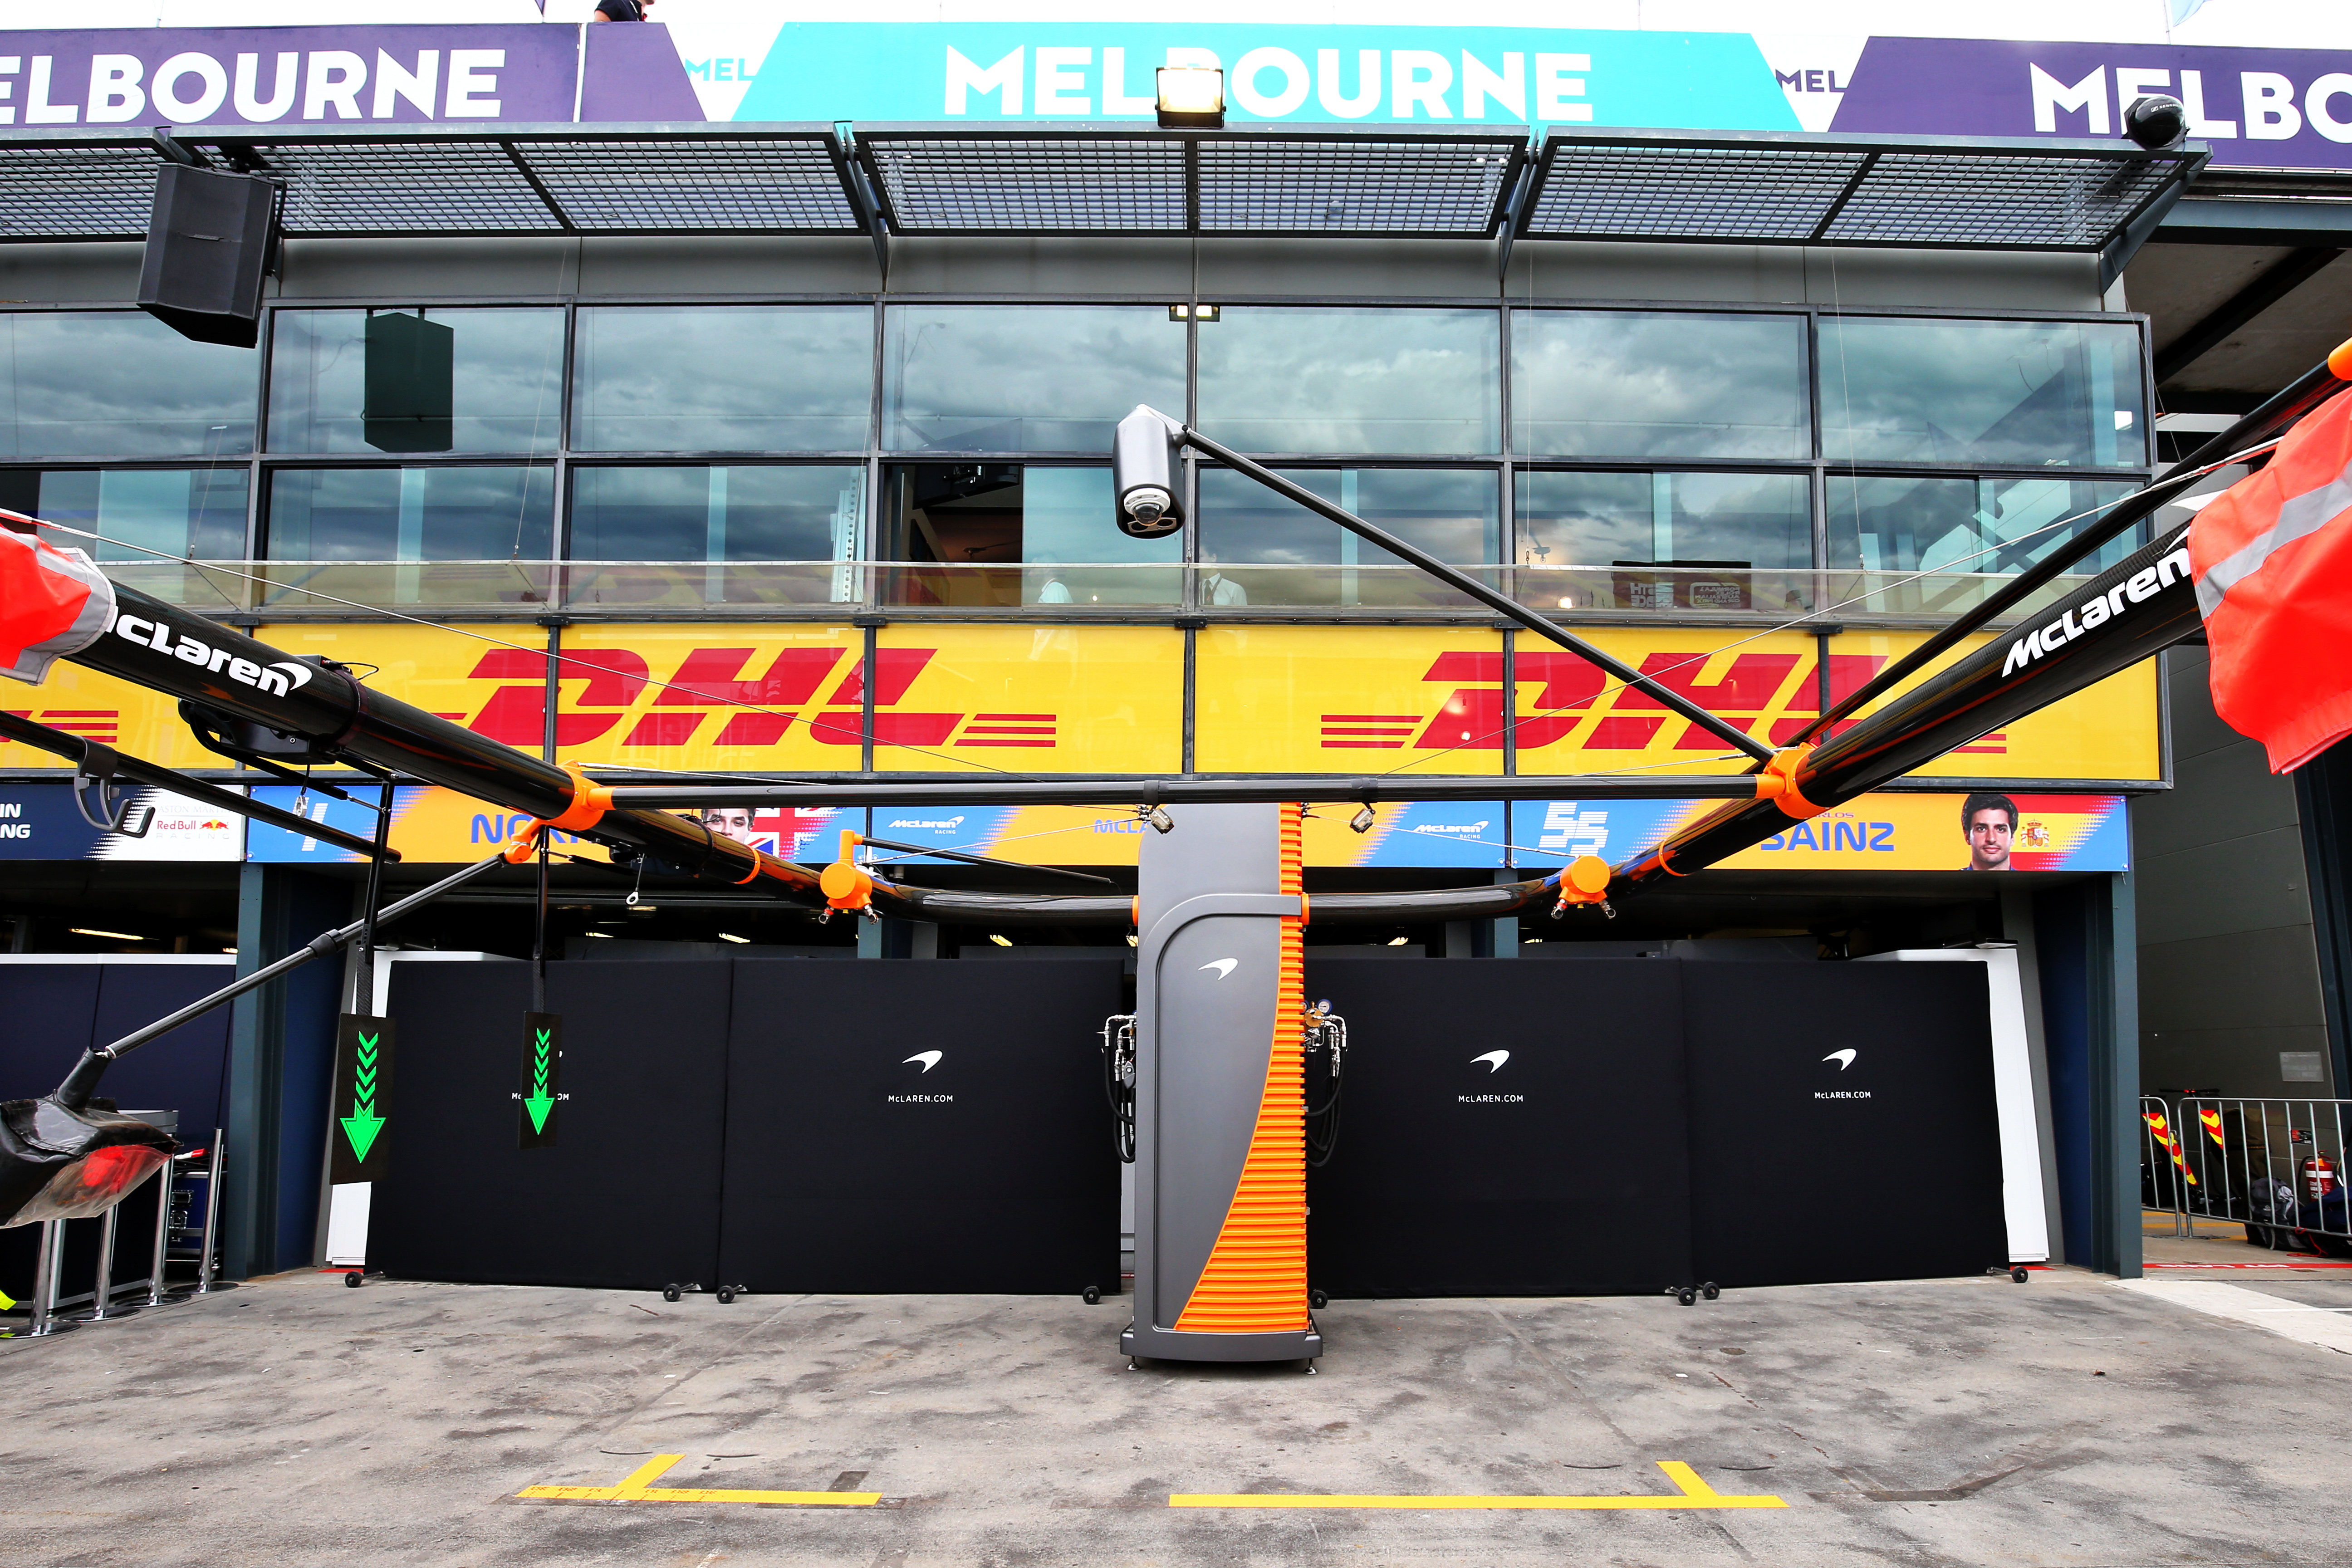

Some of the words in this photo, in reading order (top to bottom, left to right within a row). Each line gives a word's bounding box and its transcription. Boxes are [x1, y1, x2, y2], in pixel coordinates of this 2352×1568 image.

[945, 44, 1592, 122] MELOURNE
[1775, 69, 1848, 93] MEL
[468, 648, 963, 747] DHL
[1414, 652, 1890, 750] DHL
[157, 821, 176, 829] Red
[178, 821, 196, 829] Bull
